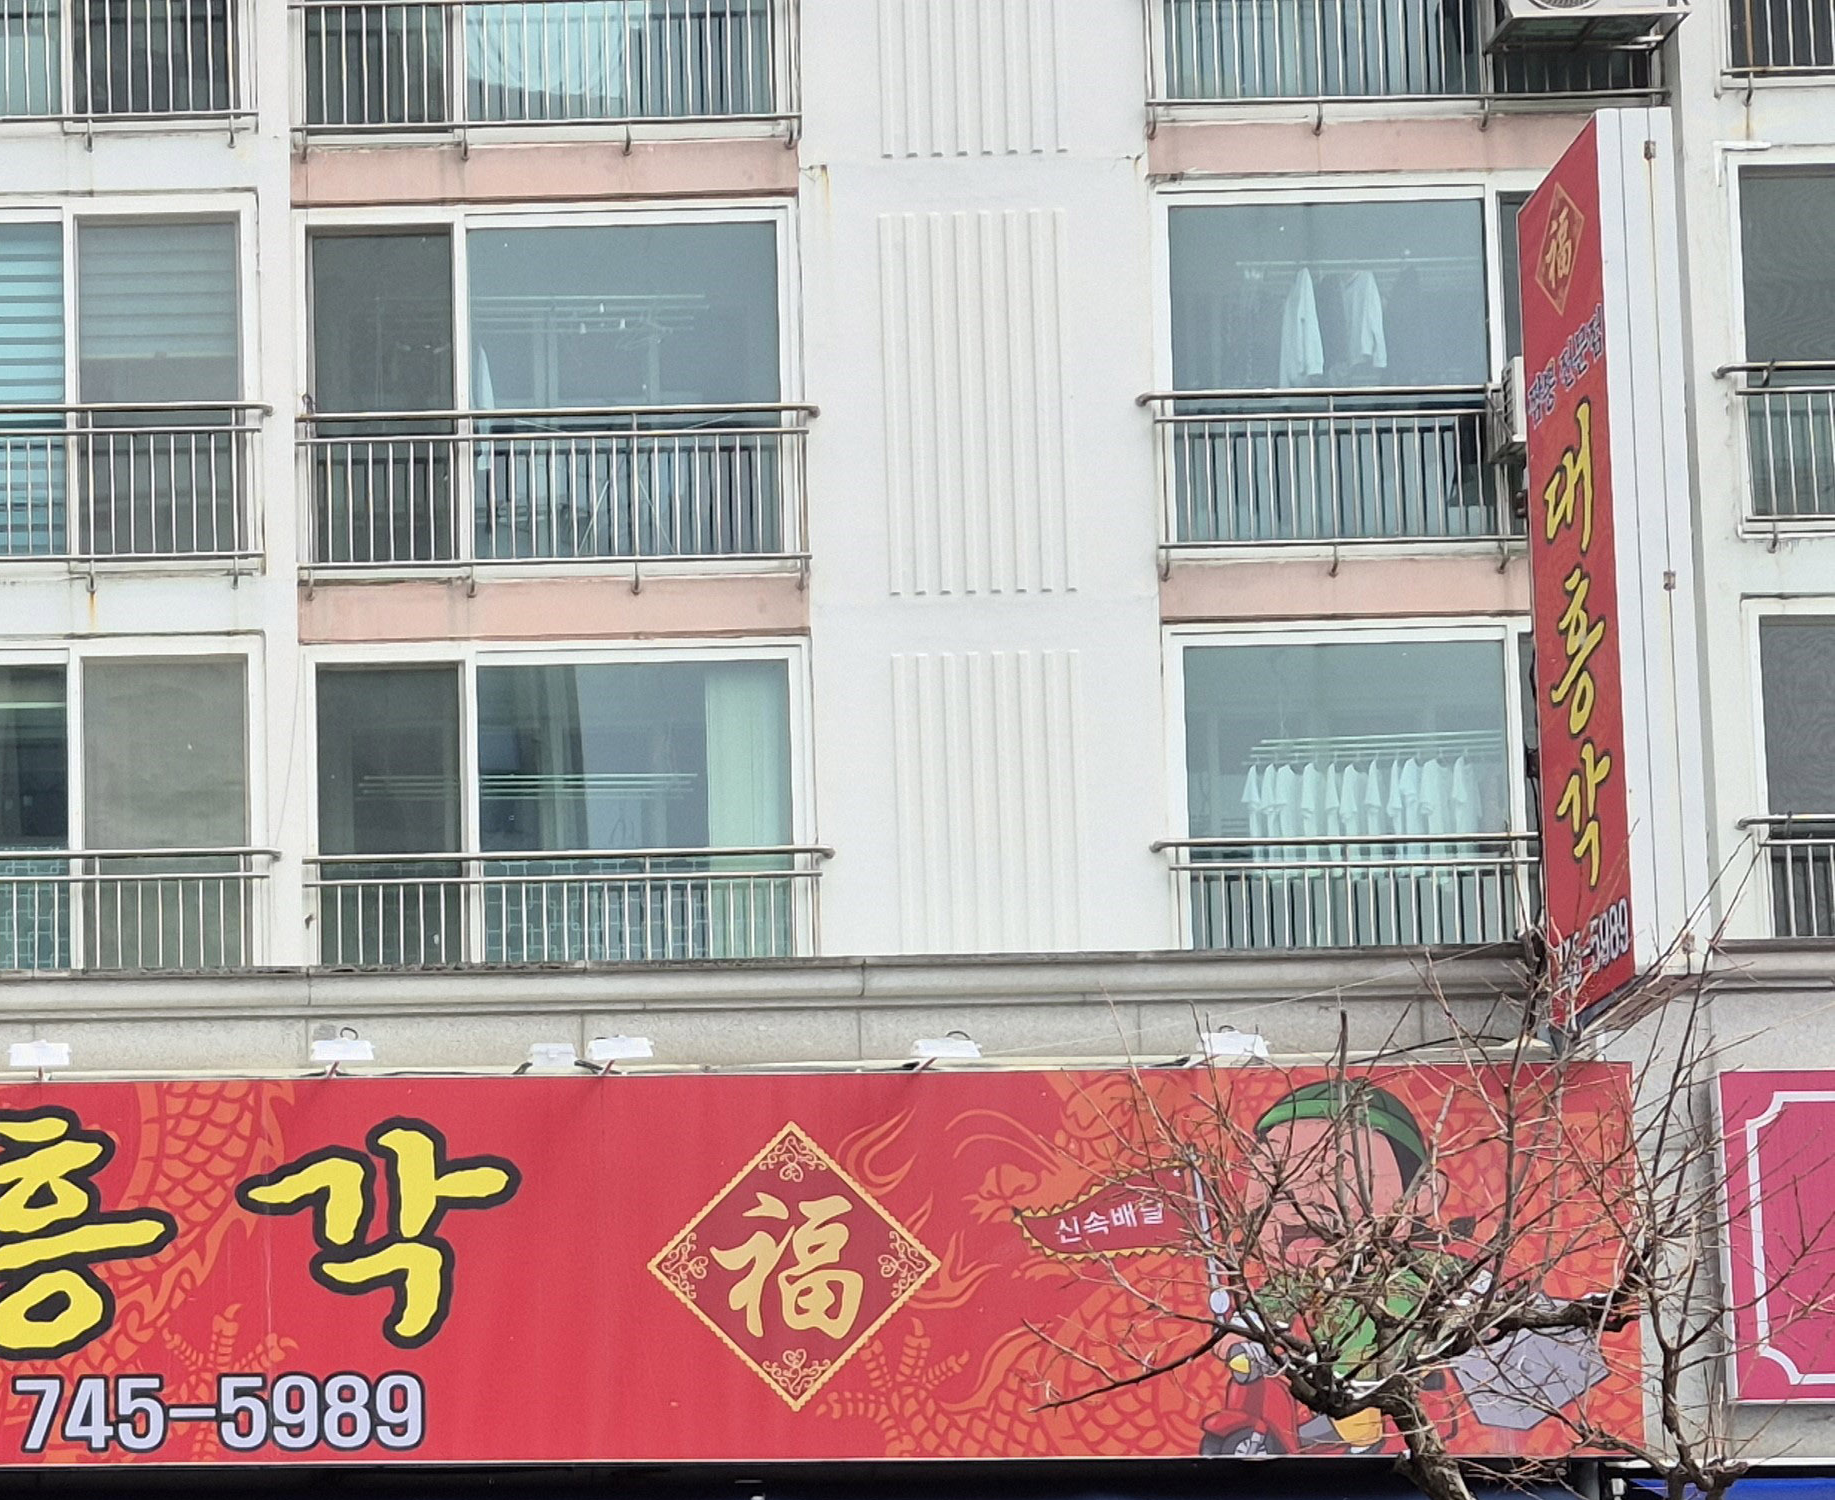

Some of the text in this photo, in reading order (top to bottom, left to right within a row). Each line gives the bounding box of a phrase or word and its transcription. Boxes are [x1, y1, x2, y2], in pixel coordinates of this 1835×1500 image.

[1546, 205, 1573, 290] 福
[1542, 395, 1614, 893] 대흥각
[1055, 1199, 1165, 1244] 신속배달
[709, 1191, 865, 1339] 福
[13, 1371, 426, 1453] 745-5989
